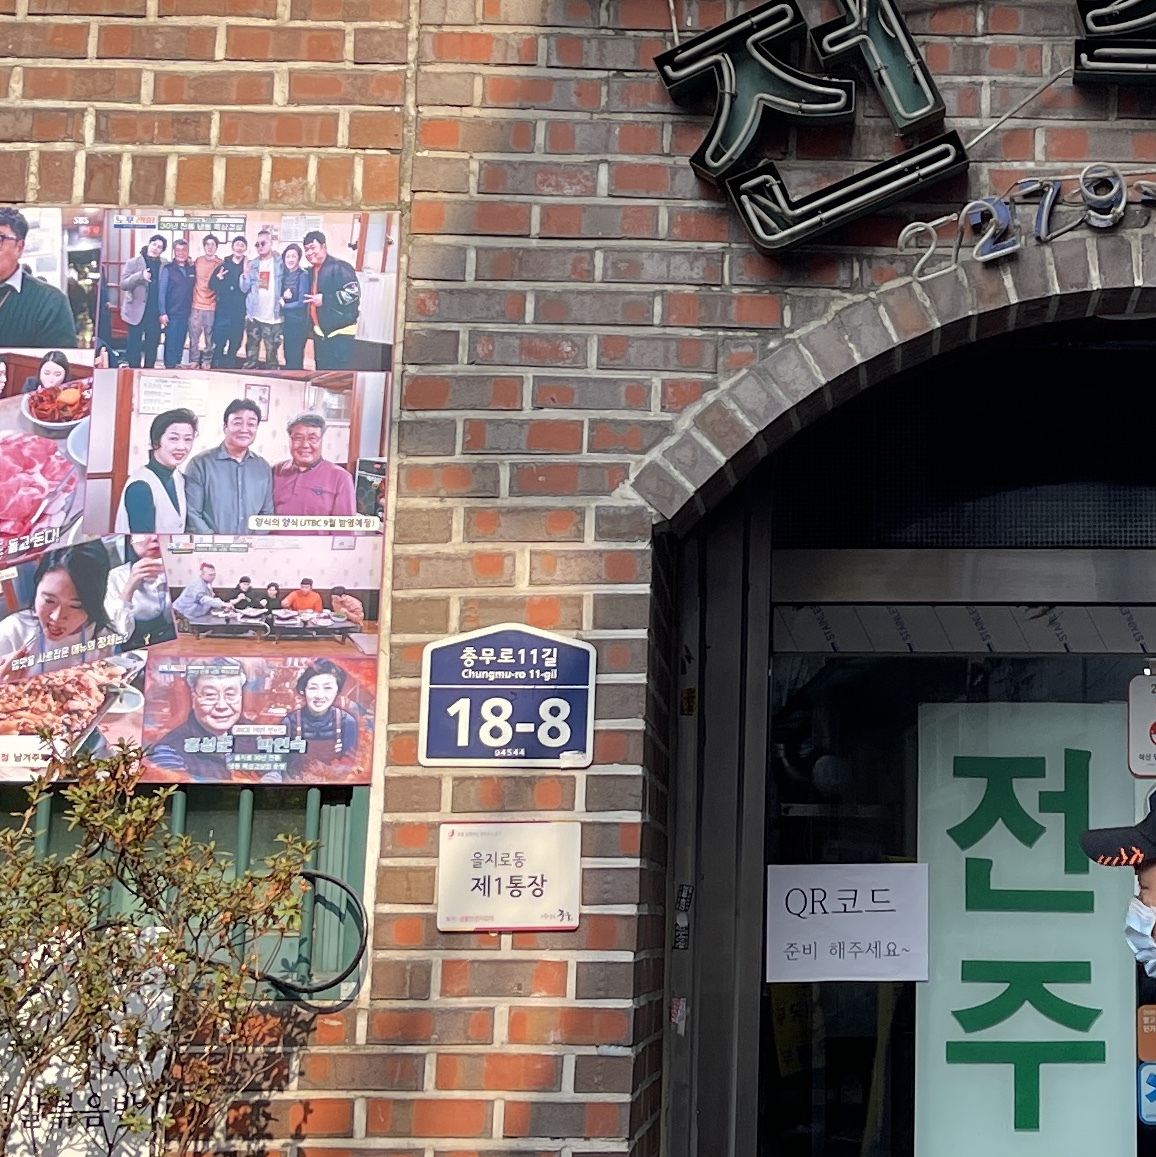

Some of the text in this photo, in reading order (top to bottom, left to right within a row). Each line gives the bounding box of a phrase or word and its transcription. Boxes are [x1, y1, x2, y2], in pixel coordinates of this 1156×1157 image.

[37, 647, 70, 664] 사로잡은
[459, 647, 558, 667] 충무로11길
[461, 668, 558, 681] Chungmu-ro 11-gil
[446, 697, 572, 748] 18-8
[494, 748, 526, 757] 04544
[470, 851, 527, 868] 을지로동
[470, 873, 548, 898] 제1통장
[784, 887, 896, 917] QR코드
[783, 940, 911, 961] 준비 해주세요~
